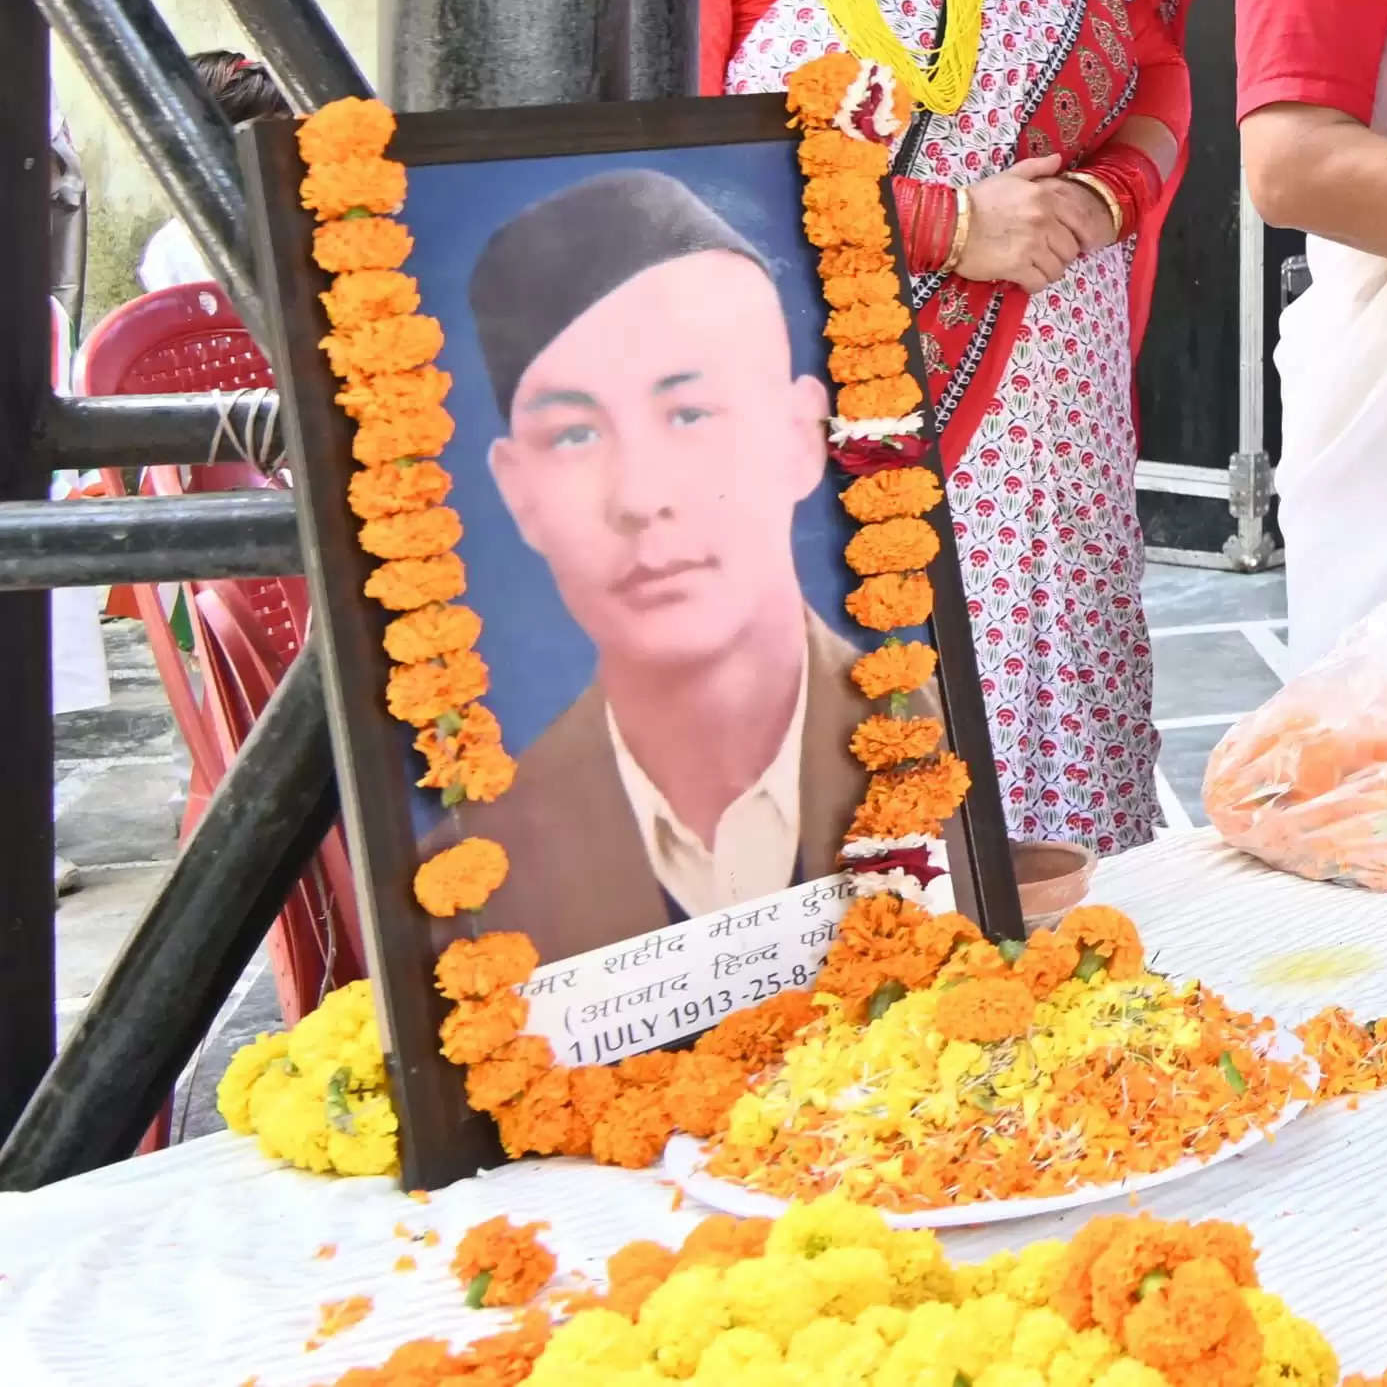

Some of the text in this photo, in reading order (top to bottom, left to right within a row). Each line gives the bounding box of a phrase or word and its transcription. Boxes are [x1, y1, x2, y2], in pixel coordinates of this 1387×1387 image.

[603, 933, 687, 975] शहीद
[708, 902, 782, 939] मेजर
[710, 942, 780, 980] हिन्द
[800, 918, 842, 948] फौ
[568, 1041, 583, 1063] 1
[593, 1014, 660, 1063] JULY
[668, 990, 733, 1029] 1913
